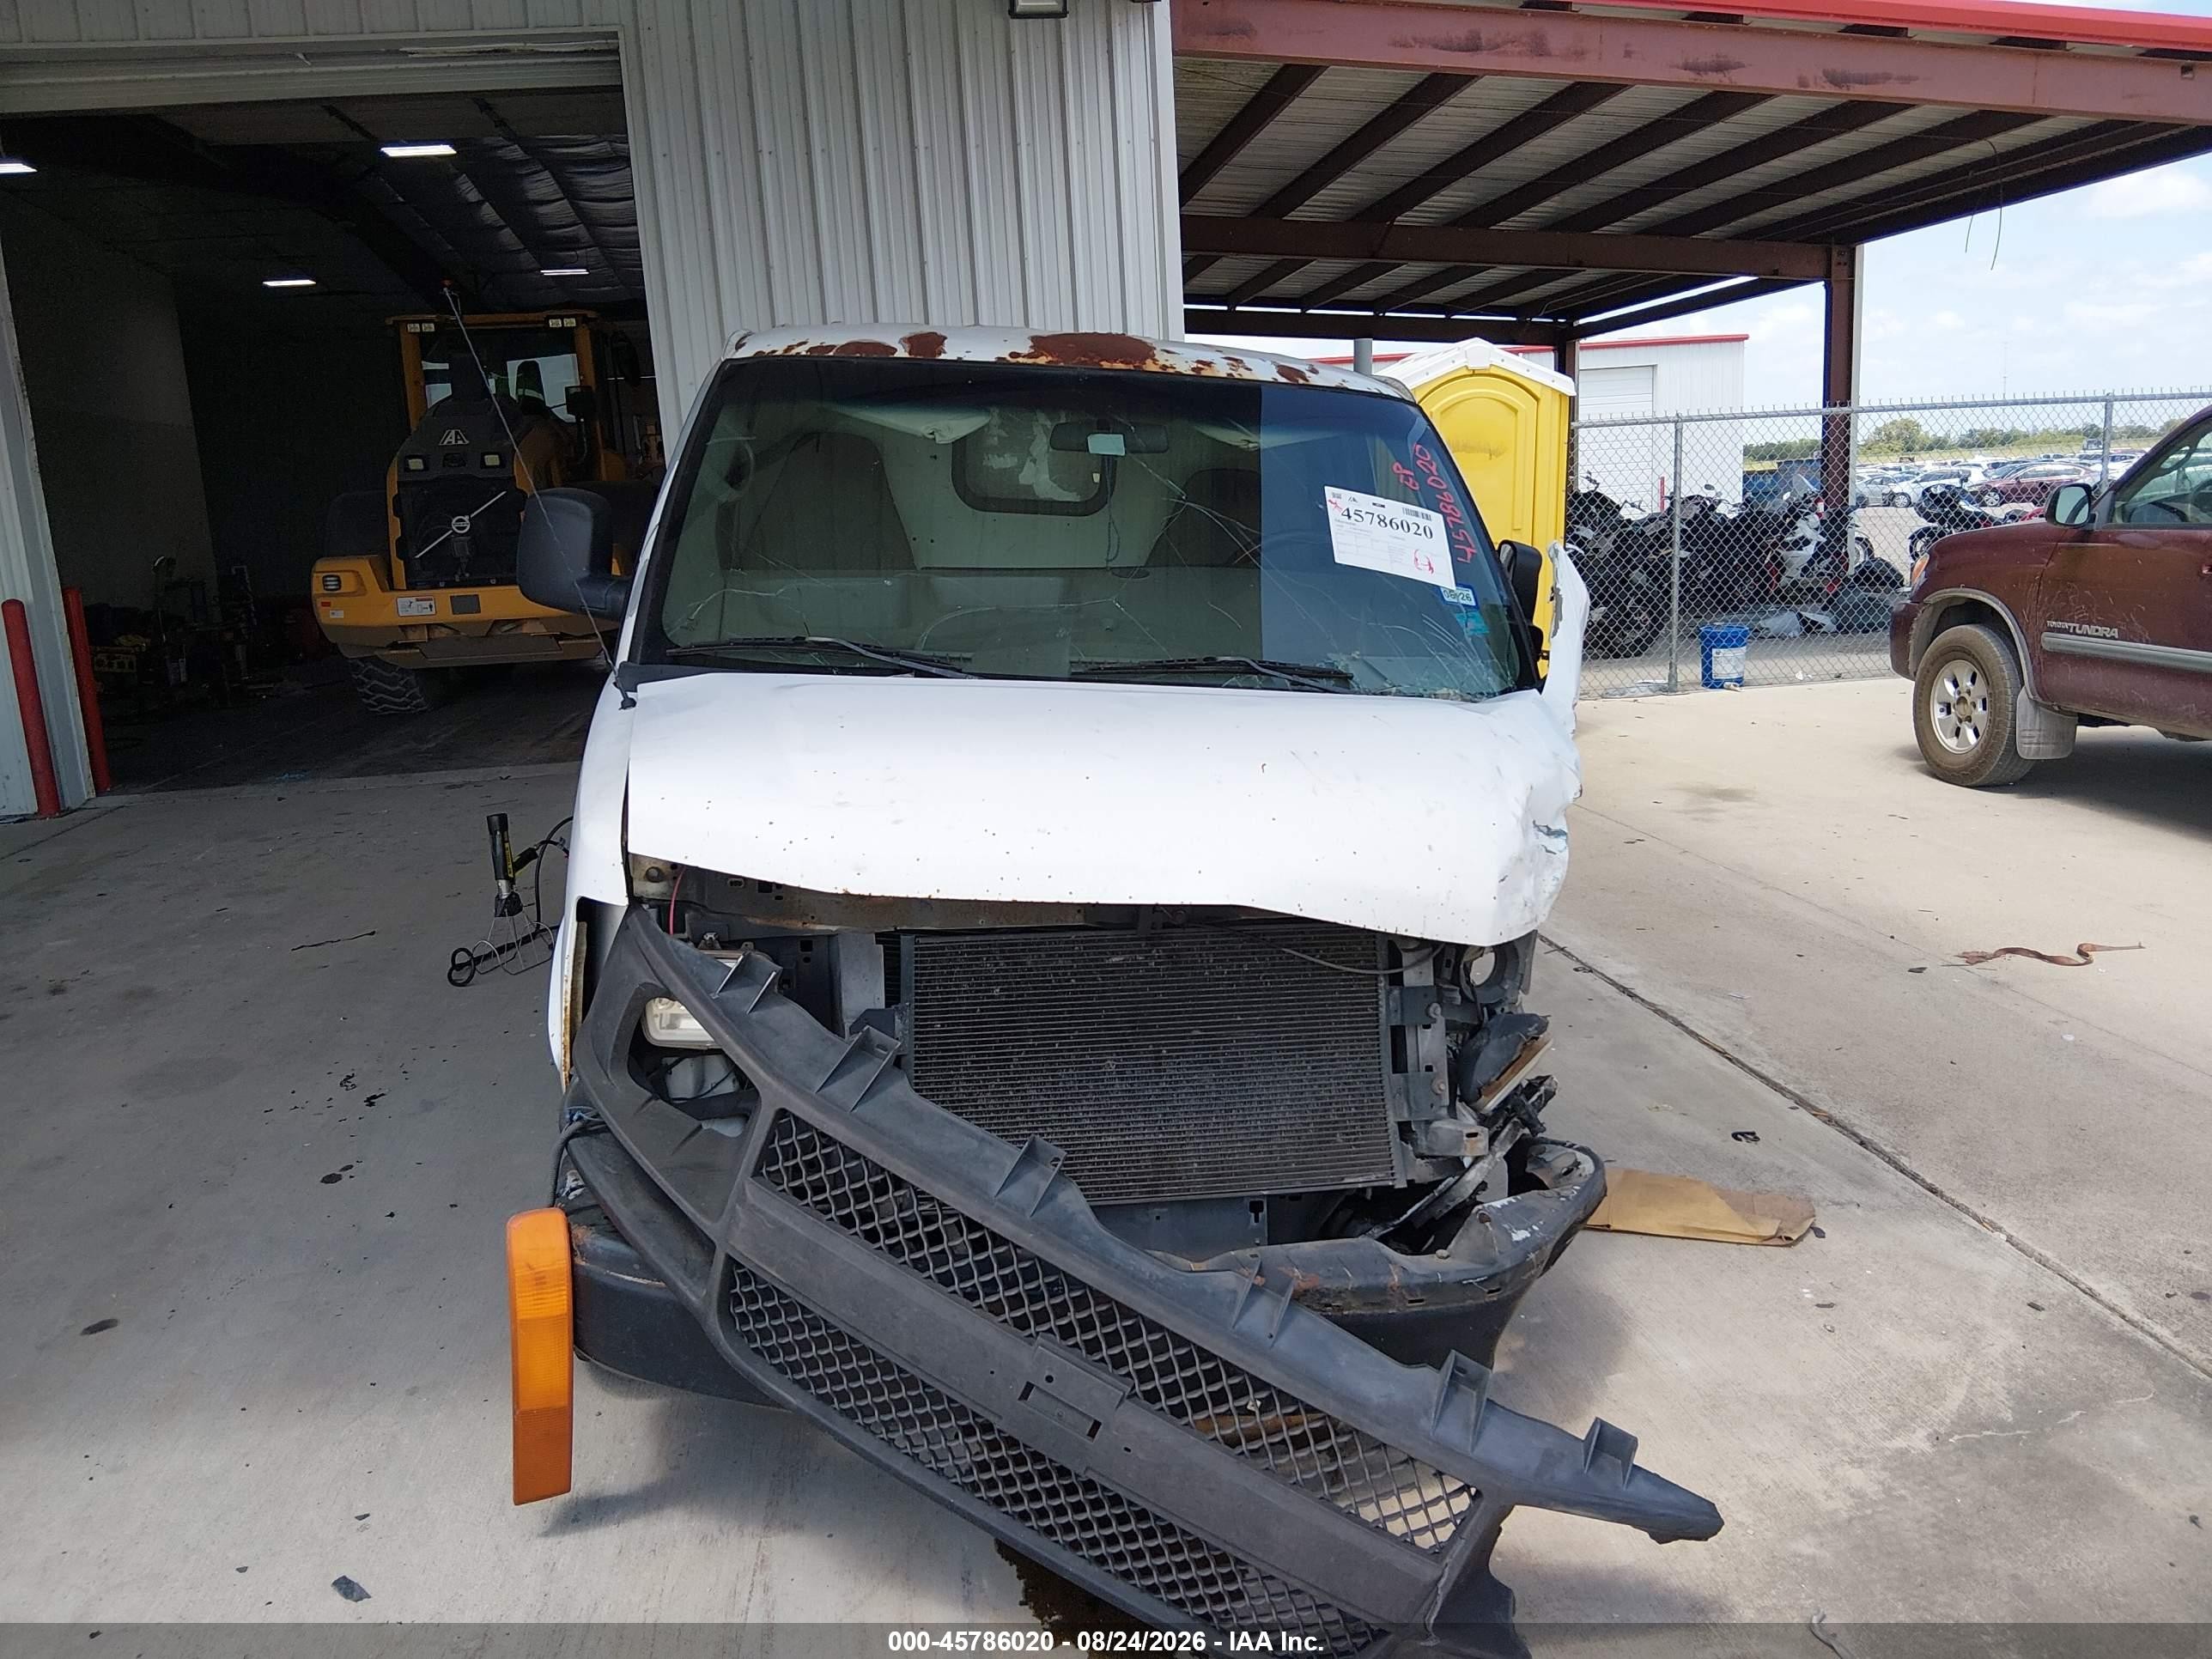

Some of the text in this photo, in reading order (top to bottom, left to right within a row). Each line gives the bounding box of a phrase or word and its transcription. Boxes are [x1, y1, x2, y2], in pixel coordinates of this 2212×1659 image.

[1413, 442, 1477, 564] 45786020
[1341, 507, 1434, 540] 45786020
[2068, 623, 2119, 639] TUNDRA
